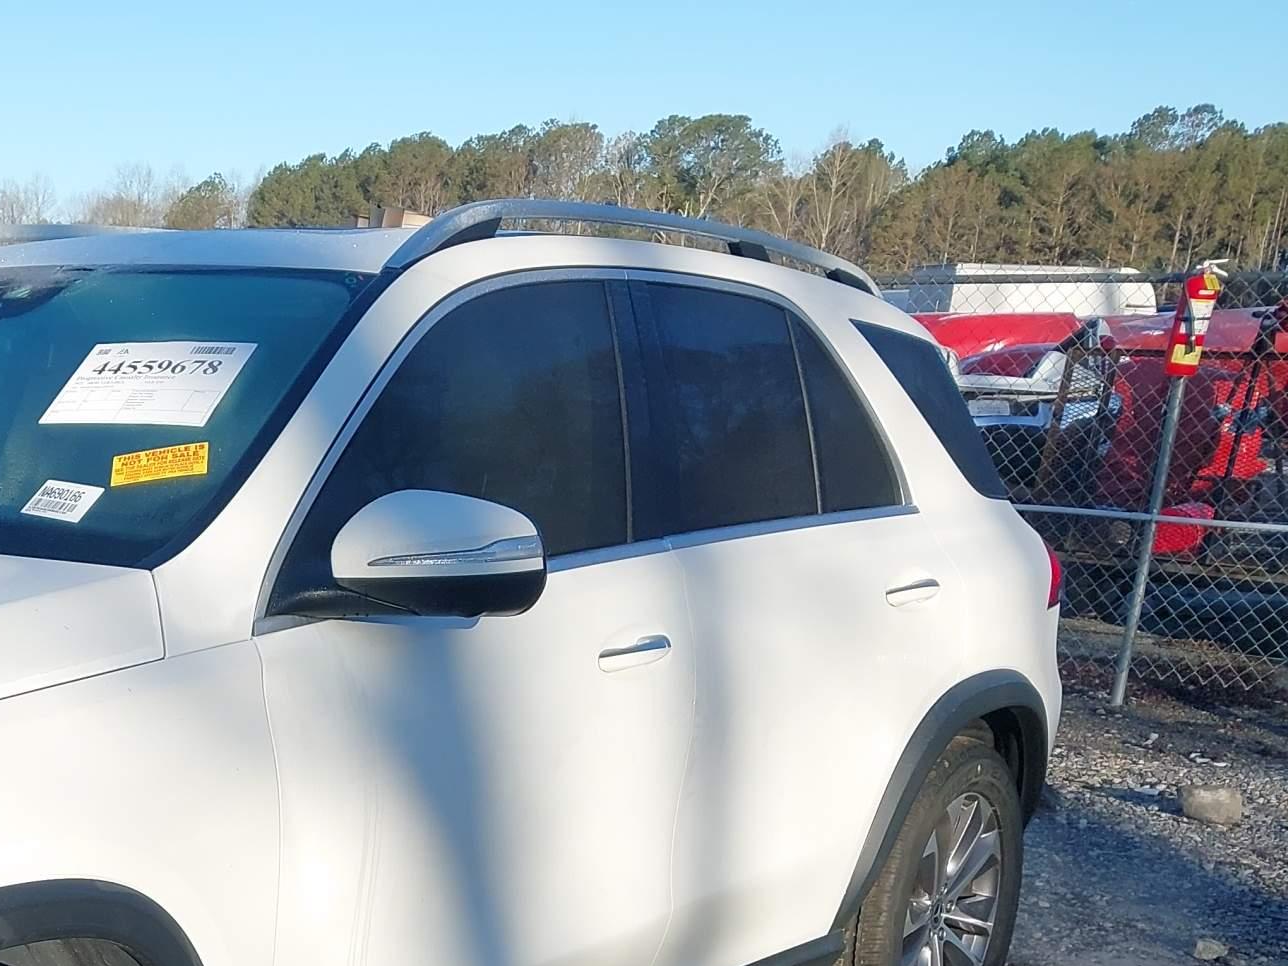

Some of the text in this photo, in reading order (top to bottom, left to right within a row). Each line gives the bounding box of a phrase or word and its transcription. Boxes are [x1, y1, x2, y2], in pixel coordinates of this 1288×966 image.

[92, 359, 223, 375] 44559678
[116, 453, 141, 463] THIS
[145, 446, 191, 458] VEHICLE
[121, 459, 143, 467] NOT
[147, 455, 168, 463] FOR
[171, 450, 200, 458] SALE
